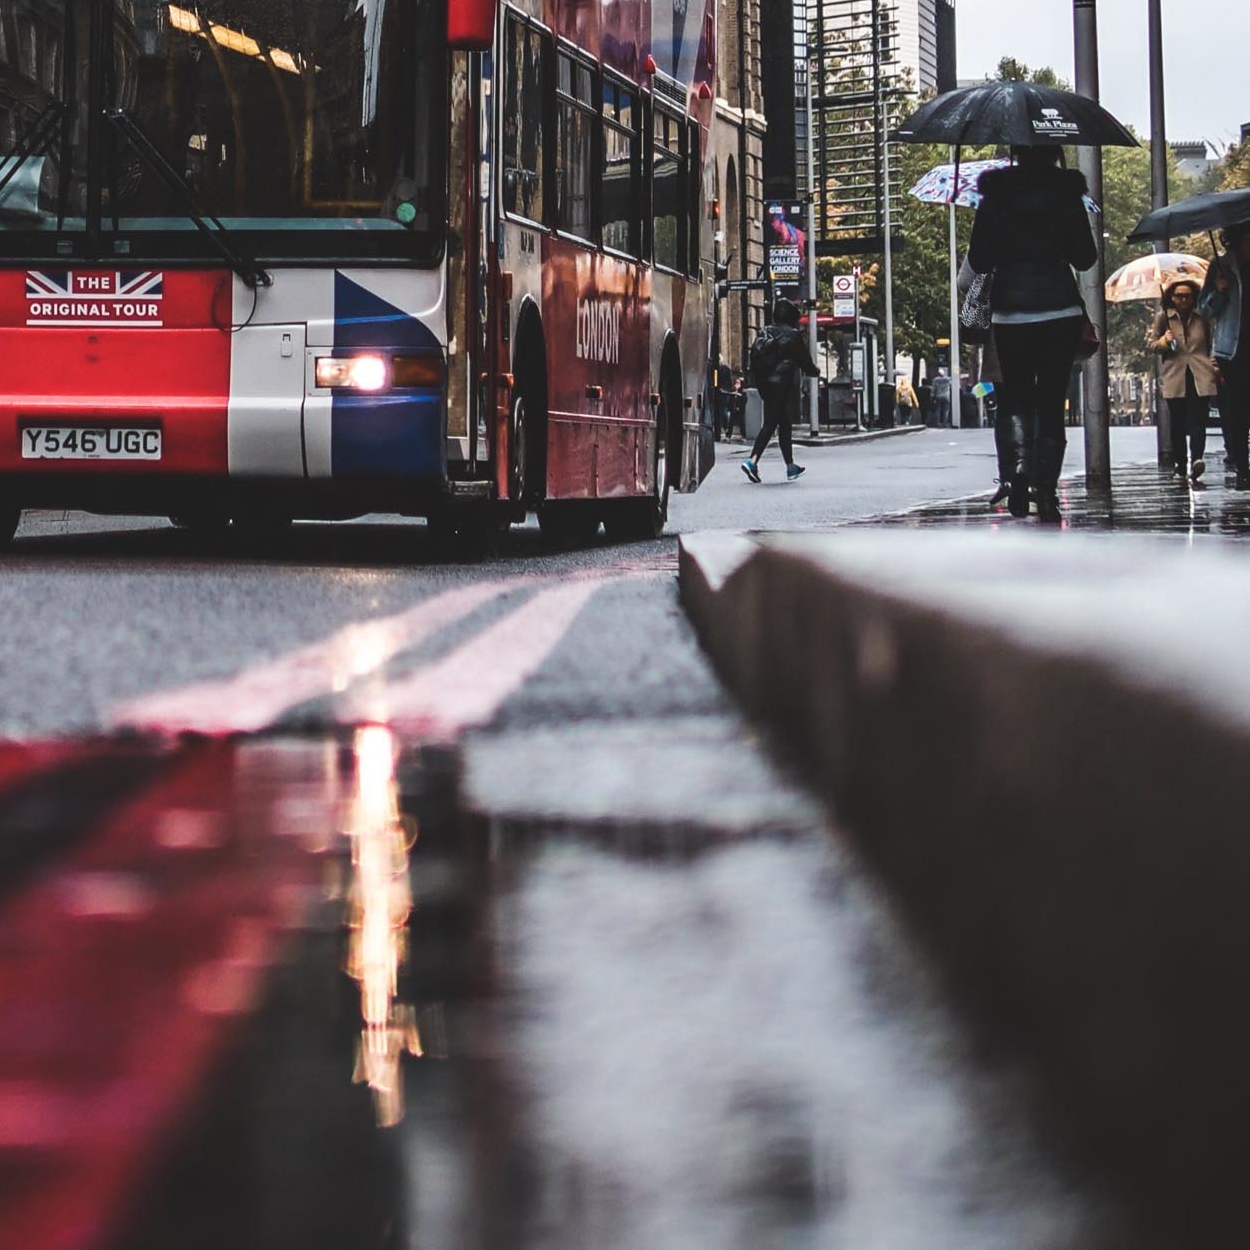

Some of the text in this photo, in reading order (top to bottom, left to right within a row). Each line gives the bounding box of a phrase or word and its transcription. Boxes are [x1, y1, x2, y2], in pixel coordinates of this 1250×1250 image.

[770, 248, 799, 256] SCIENCE
[769, 256, 800, 264] GALLERY
[770, 265, 799, 273] LONDON
[77, 276, 110, 289] THE
[30, 303, 158, 316] ORIGINAL TOUR
[576, 298, 620, 364] LONDON
[26, 429, 159, 454] Y546 UGC
